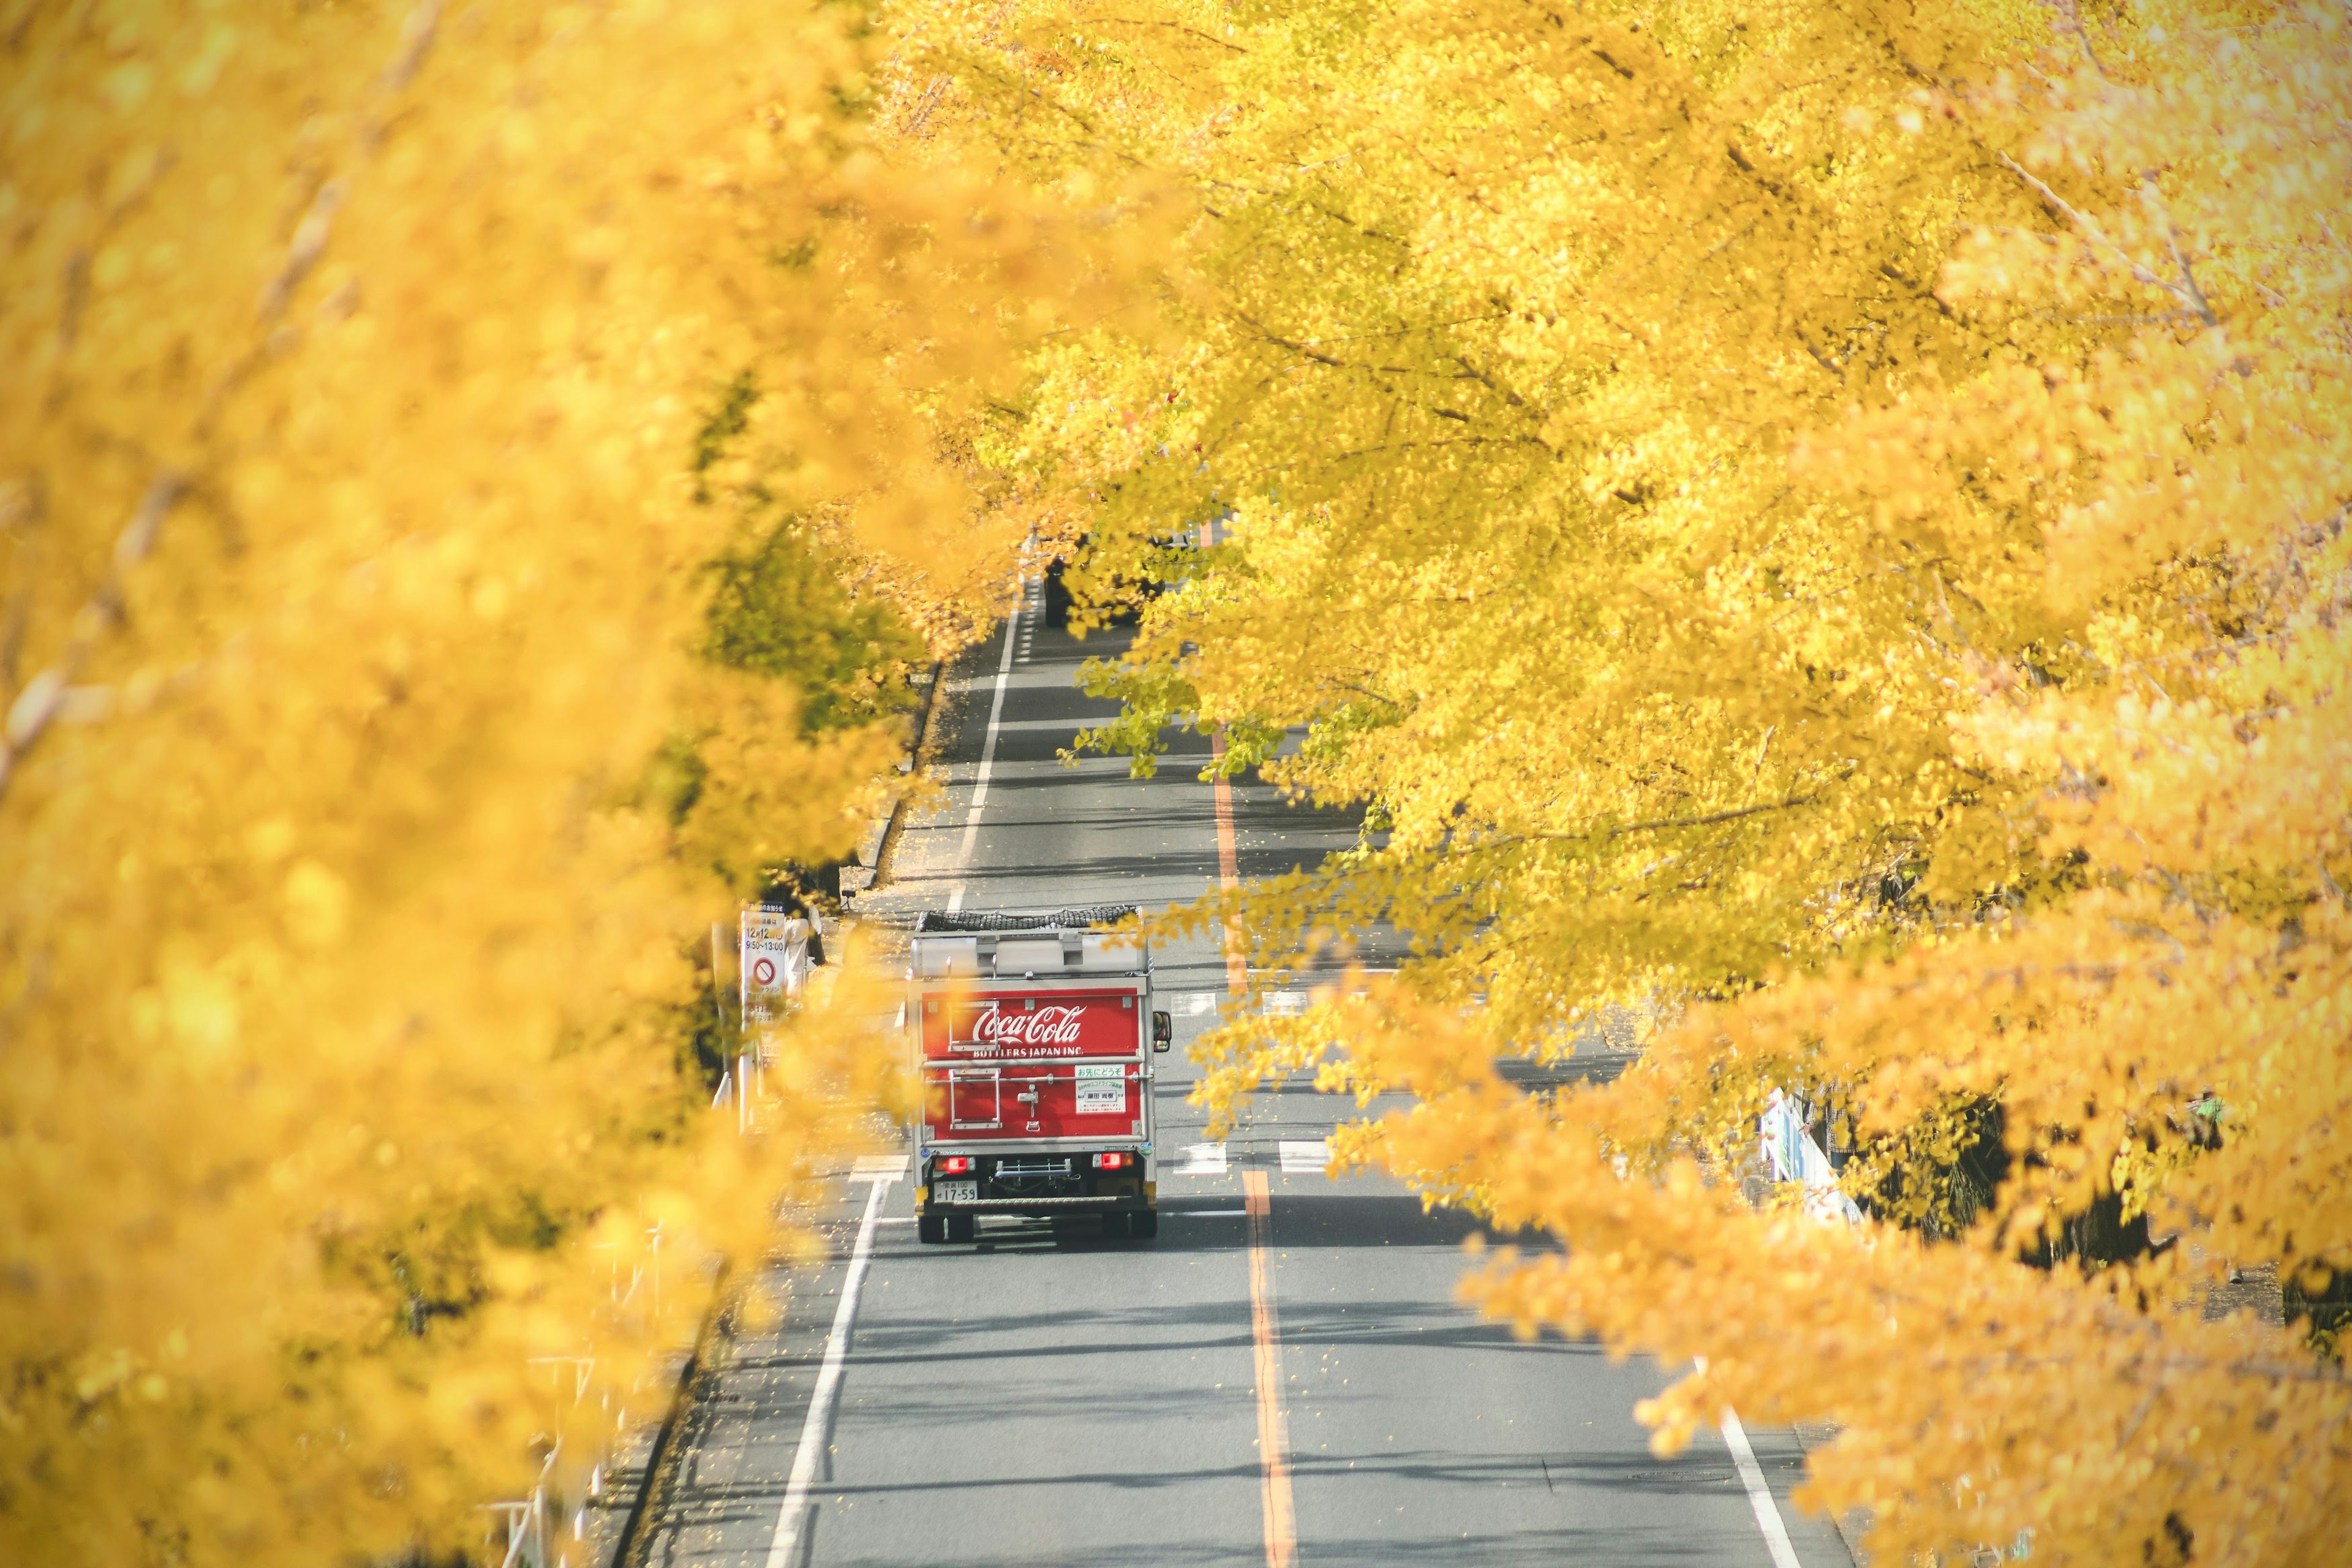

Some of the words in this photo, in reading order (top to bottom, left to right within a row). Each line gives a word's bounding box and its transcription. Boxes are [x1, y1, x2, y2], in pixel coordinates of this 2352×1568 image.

[747, 927, 783, 940] 12月12
[973, 1006, 1087, 1044] Coca-Cola
[973, 1048, 1027, 1057] BOTTLERS
[1030, 1047, 1060, 1057] JAPAN
[1078, 1067, 1122, 1077] お先にどうぞ
[945, 1189, 975, 1200] 17-59
